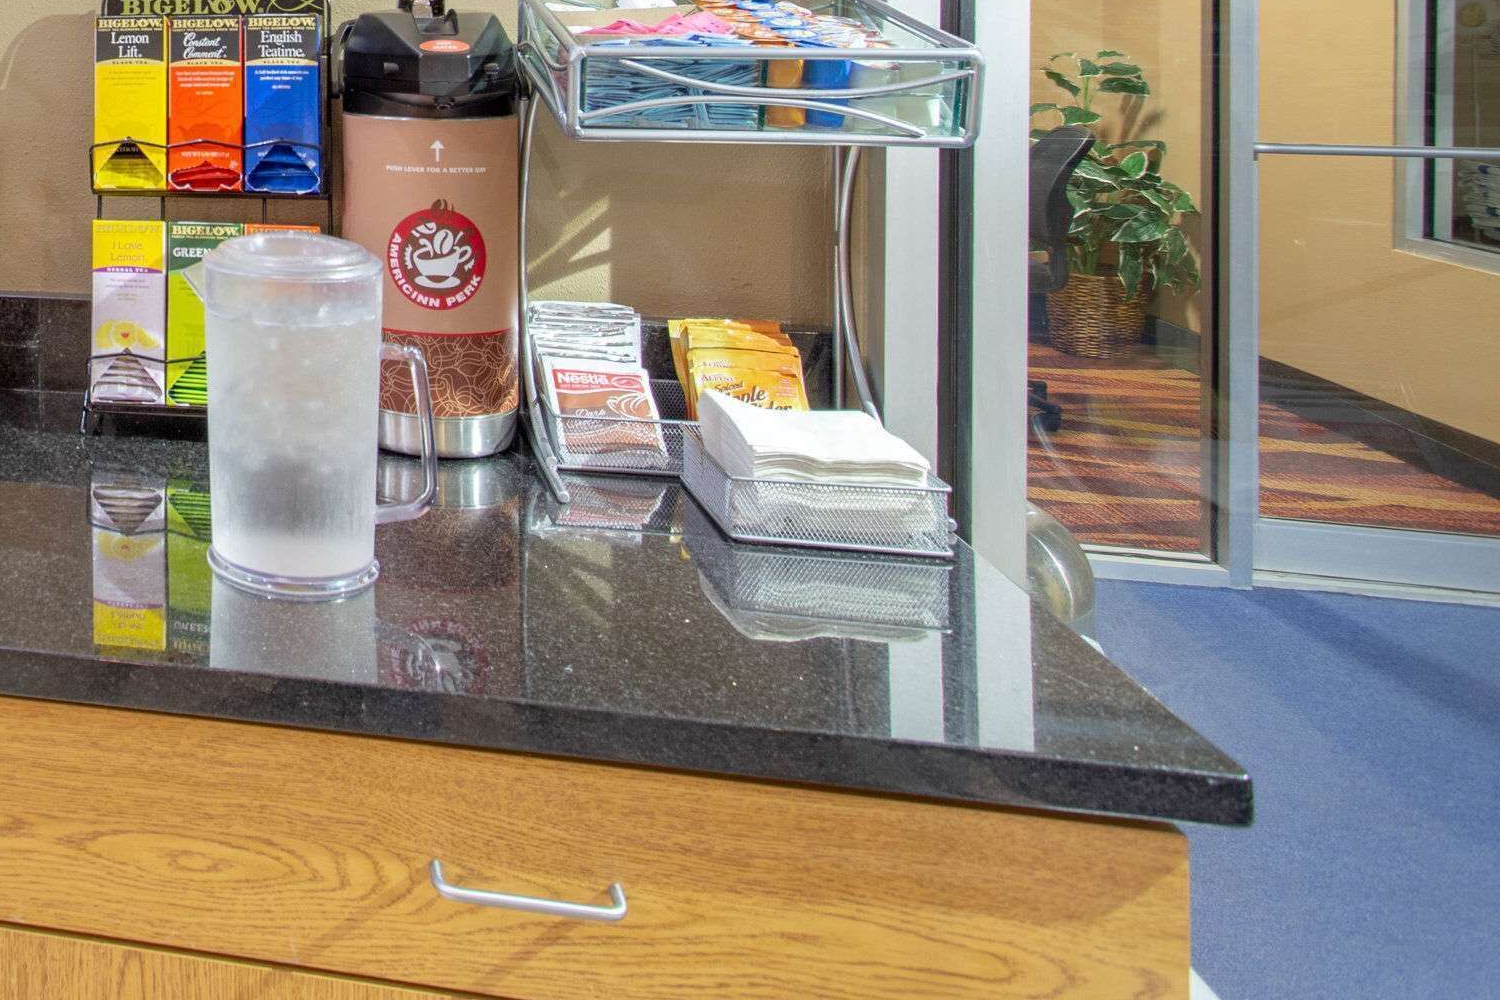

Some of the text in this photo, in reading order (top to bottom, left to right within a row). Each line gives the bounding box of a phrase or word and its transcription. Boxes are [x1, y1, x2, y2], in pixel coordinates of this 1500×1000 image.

[111, 31, 149, 44] Lemon
[260, 30, 302, 45] English
[388, 232, 482, 308] AMERICINN PERK
